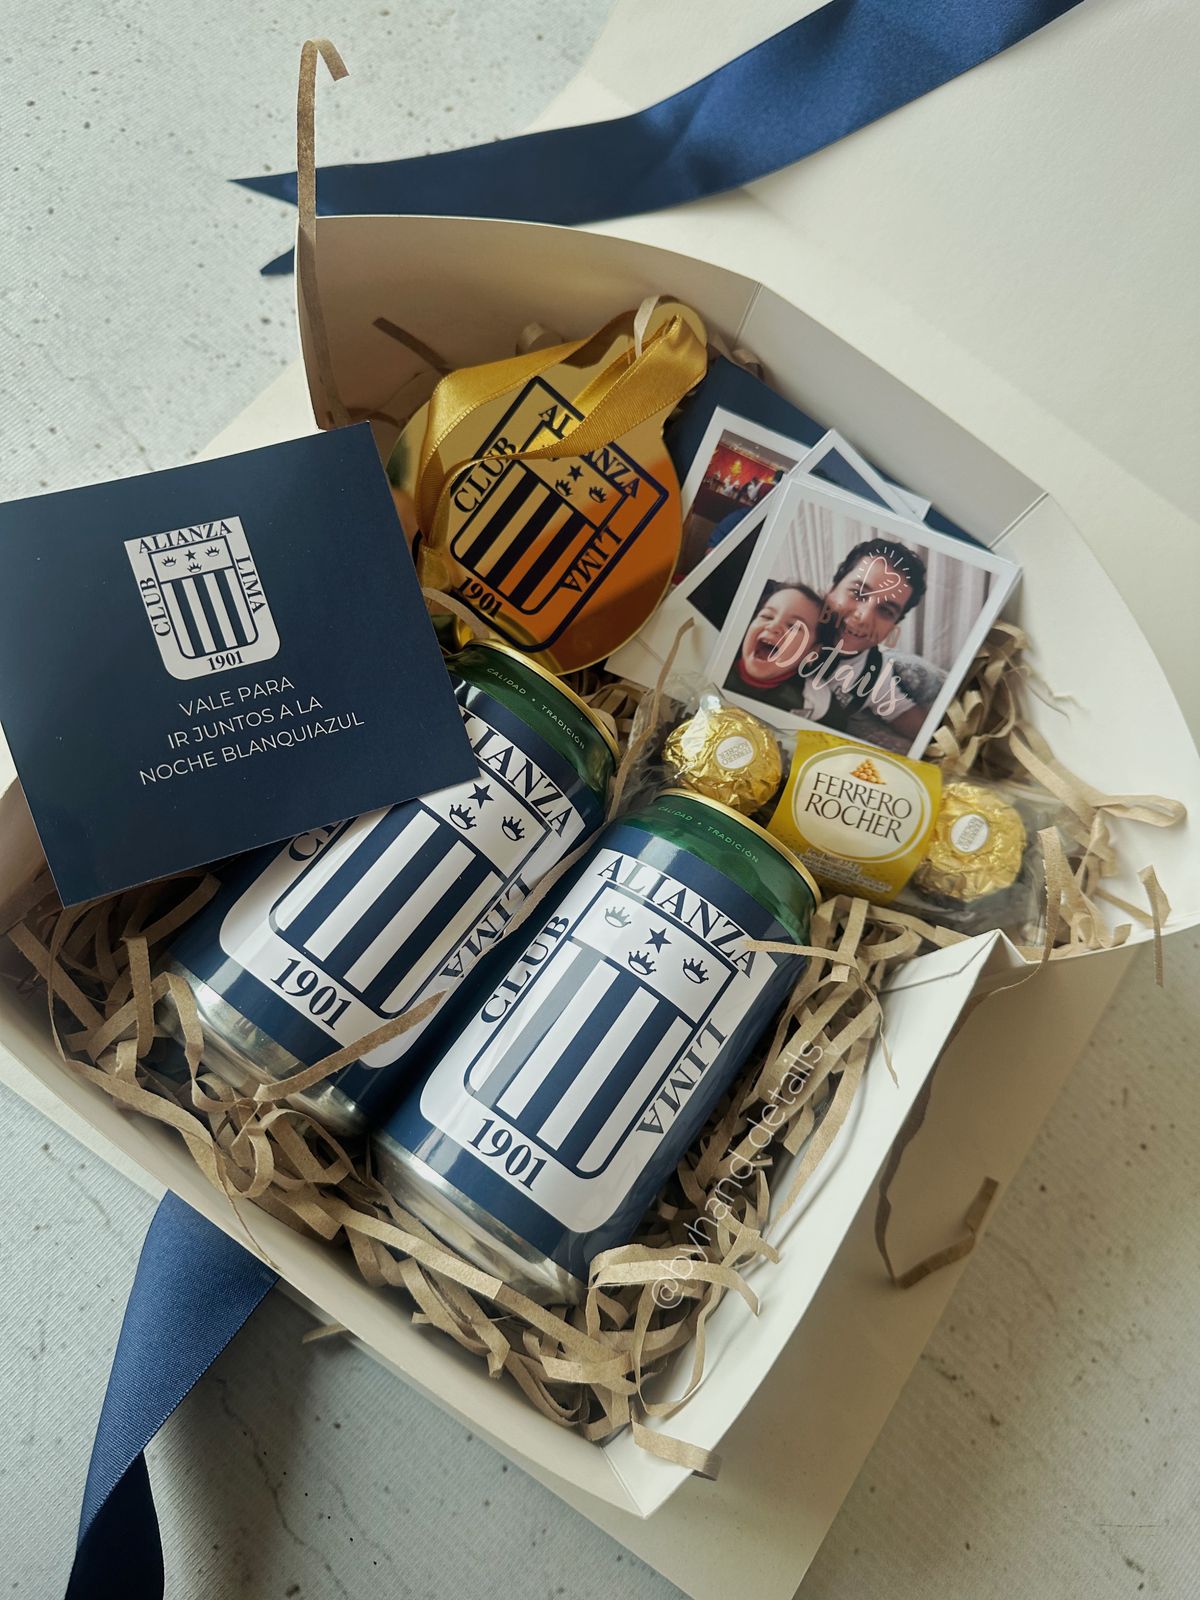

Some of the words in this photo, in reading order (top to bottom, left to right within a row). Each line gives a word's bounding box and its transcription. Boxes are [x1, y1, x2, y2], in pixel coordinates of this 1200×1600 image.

[454, 437, 517, 514] CLUB
[138, 520, 233, 554] ALIANZA
[559, 525, 622, 592] LIMA
[139, 576, 172, 637] CLUB
[236, 555, 267, 614] LIMA
[458, 576, 503, 618] 1901
[207, 650, 245, 671] 1901
[486, 667, 527, 695] CALIDAD
[167, 731, 190, 749] IR
[192, 708, 274, 743] JUNTOS
[279, 704, 294, 720] A
[296, 696, 323, 714] LA
[178, 690, 235, 717] VALE
[237, 676, 295, 702] PARA
[139, 750, 218, 785] NOCHE
[221, 712, 365, 763] BLANQUIAZUL
[463, 709, 574, 838] IANZA
[804, 792, 902, 843] ROCHER
[812, 771, 912, 820] FERRERO
[657, 806, 693, 821] CALIDAD
[707, 826, 759, 864] TRADICIÓN
[440, 873, 534, 978] LIMA
[597, 855, 757, 979] ALIANZA
[270, 957, 352, 1031] 1901
[481, 915, 570, 1024] CLUB
[635, 1018, 728, 1136] LIMA
[467, 1117, 548, 1191] 1901
